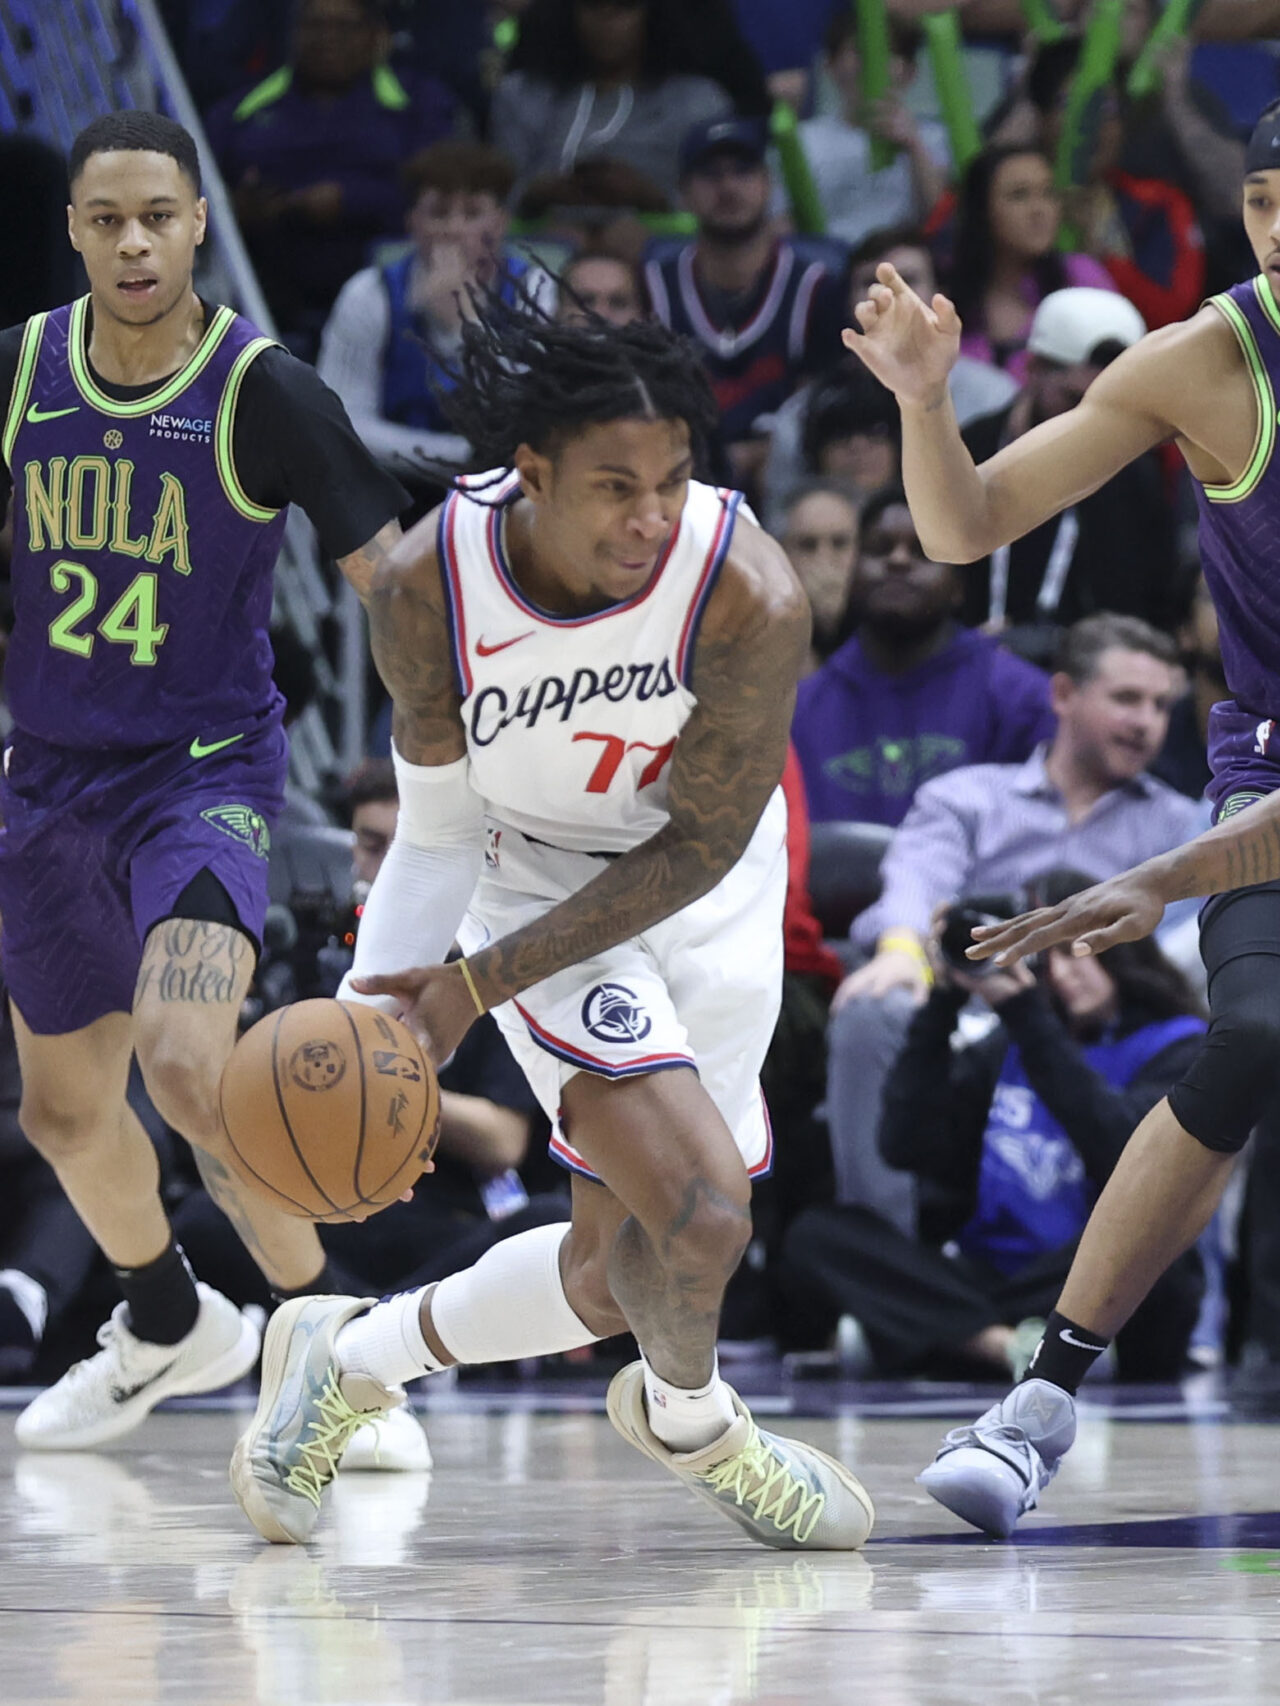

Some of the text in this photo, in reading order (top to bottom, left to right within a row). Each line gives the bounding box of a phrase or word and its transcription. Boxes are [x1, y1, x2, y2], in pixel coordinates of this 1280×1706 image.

[149, 429, 211, 445] PRODUCTS
[150, 413, 213, 434] NEWAGE
[25, 455, 192, 576] NOLA
[48, 559, 170, 666] 24
[571, 731, 679, 794] 77
